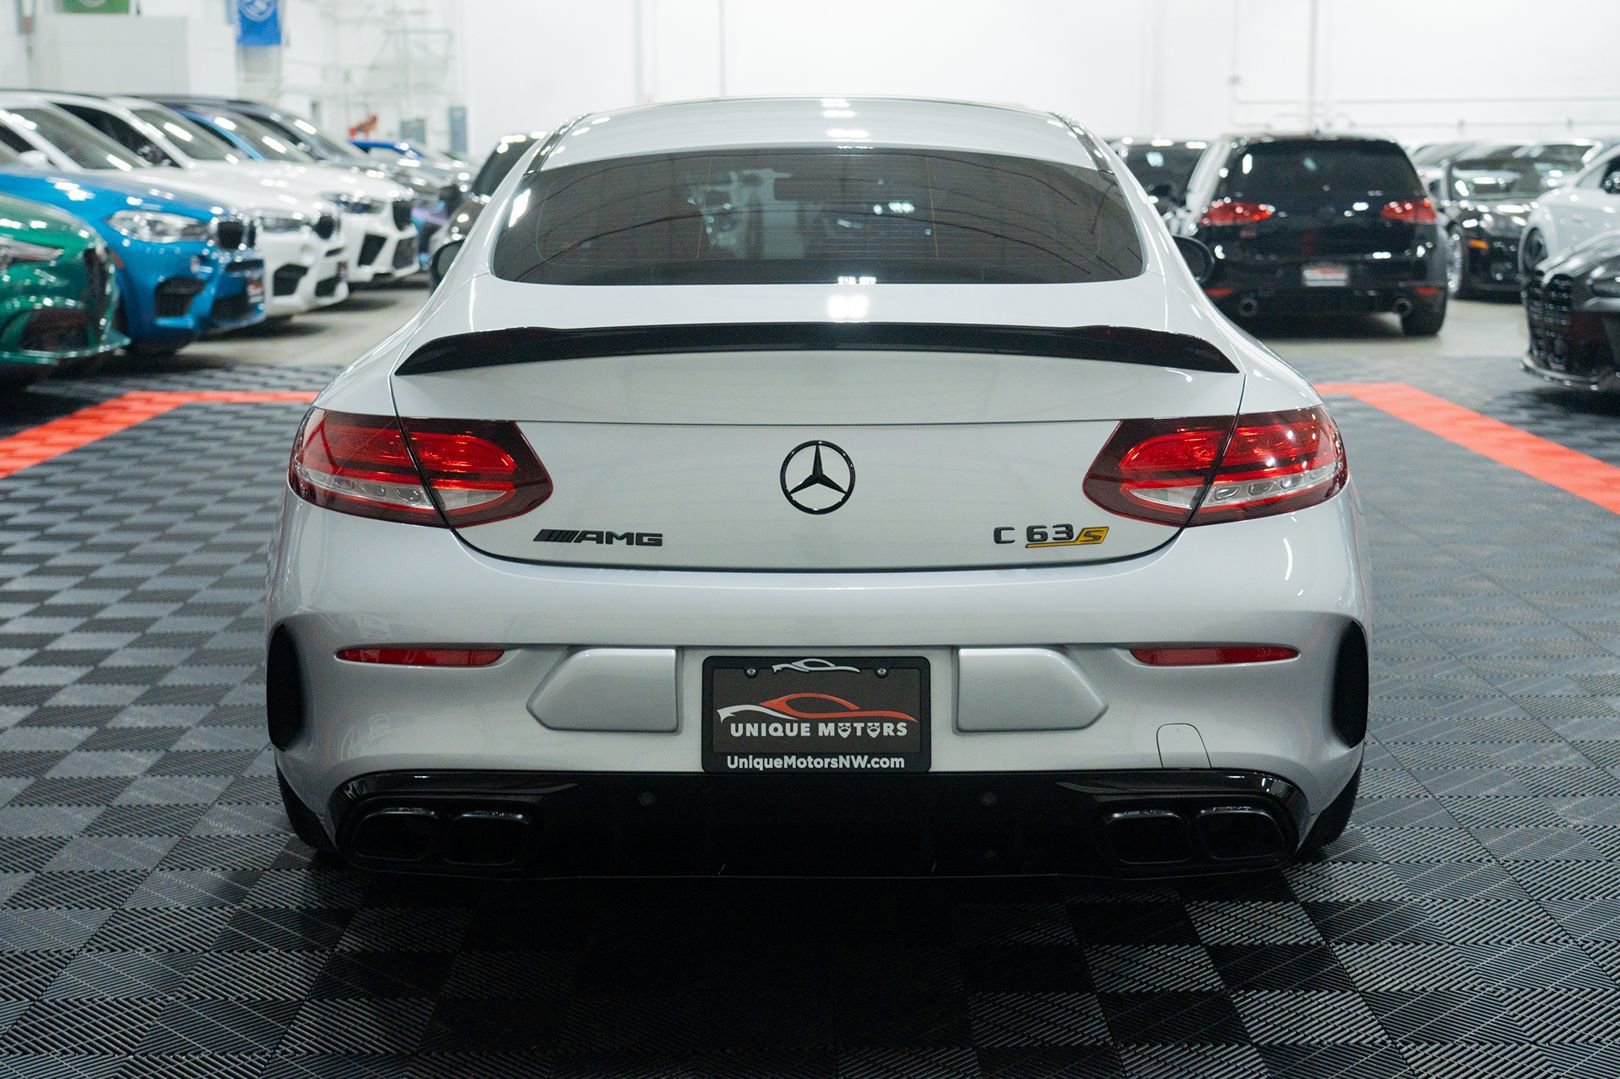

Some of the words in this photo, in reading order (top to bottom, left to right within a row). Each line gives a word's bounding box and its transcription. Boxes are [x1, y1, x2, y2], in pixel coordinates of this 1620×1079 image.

[573, 530, 663, 547] AMG
[993, 526, 1016, 545] C
[730, 722, 811, 737] UNIQUE
[818, 722, 908, 739] MOTORS
[727, 755, 905, 771] UniqueMotorsNW.com
